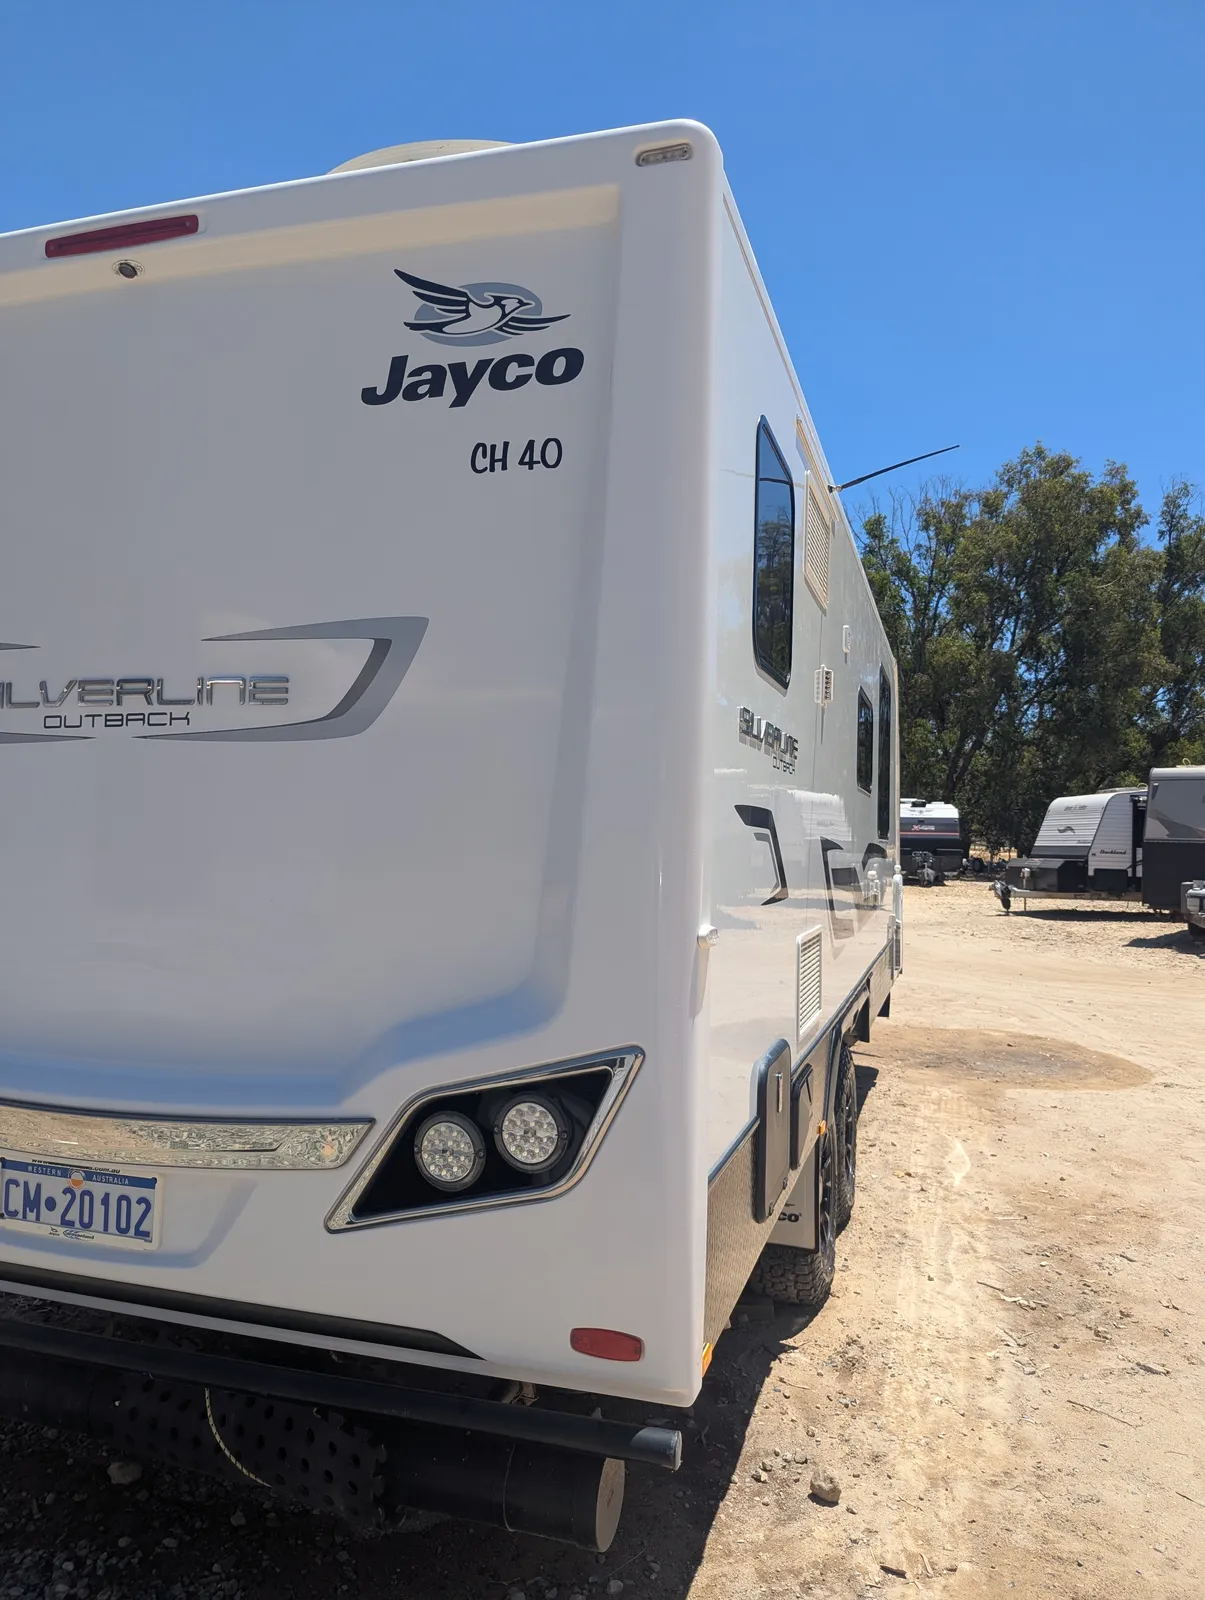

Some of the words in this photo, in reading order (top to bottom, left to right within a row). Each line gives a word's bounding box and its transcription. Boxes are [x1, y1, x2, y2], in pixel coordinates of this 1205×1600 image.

[361, 347, 584, 408] Jayco
[470, 441, 510, 474] CH
[518, 437, 563, 470] 40
[43, 711, 190, 729] OUTBACK
[27, 1165, 62, 1177] WESTERN
[92, 1174, 129, 1186] AUSTRALIA
